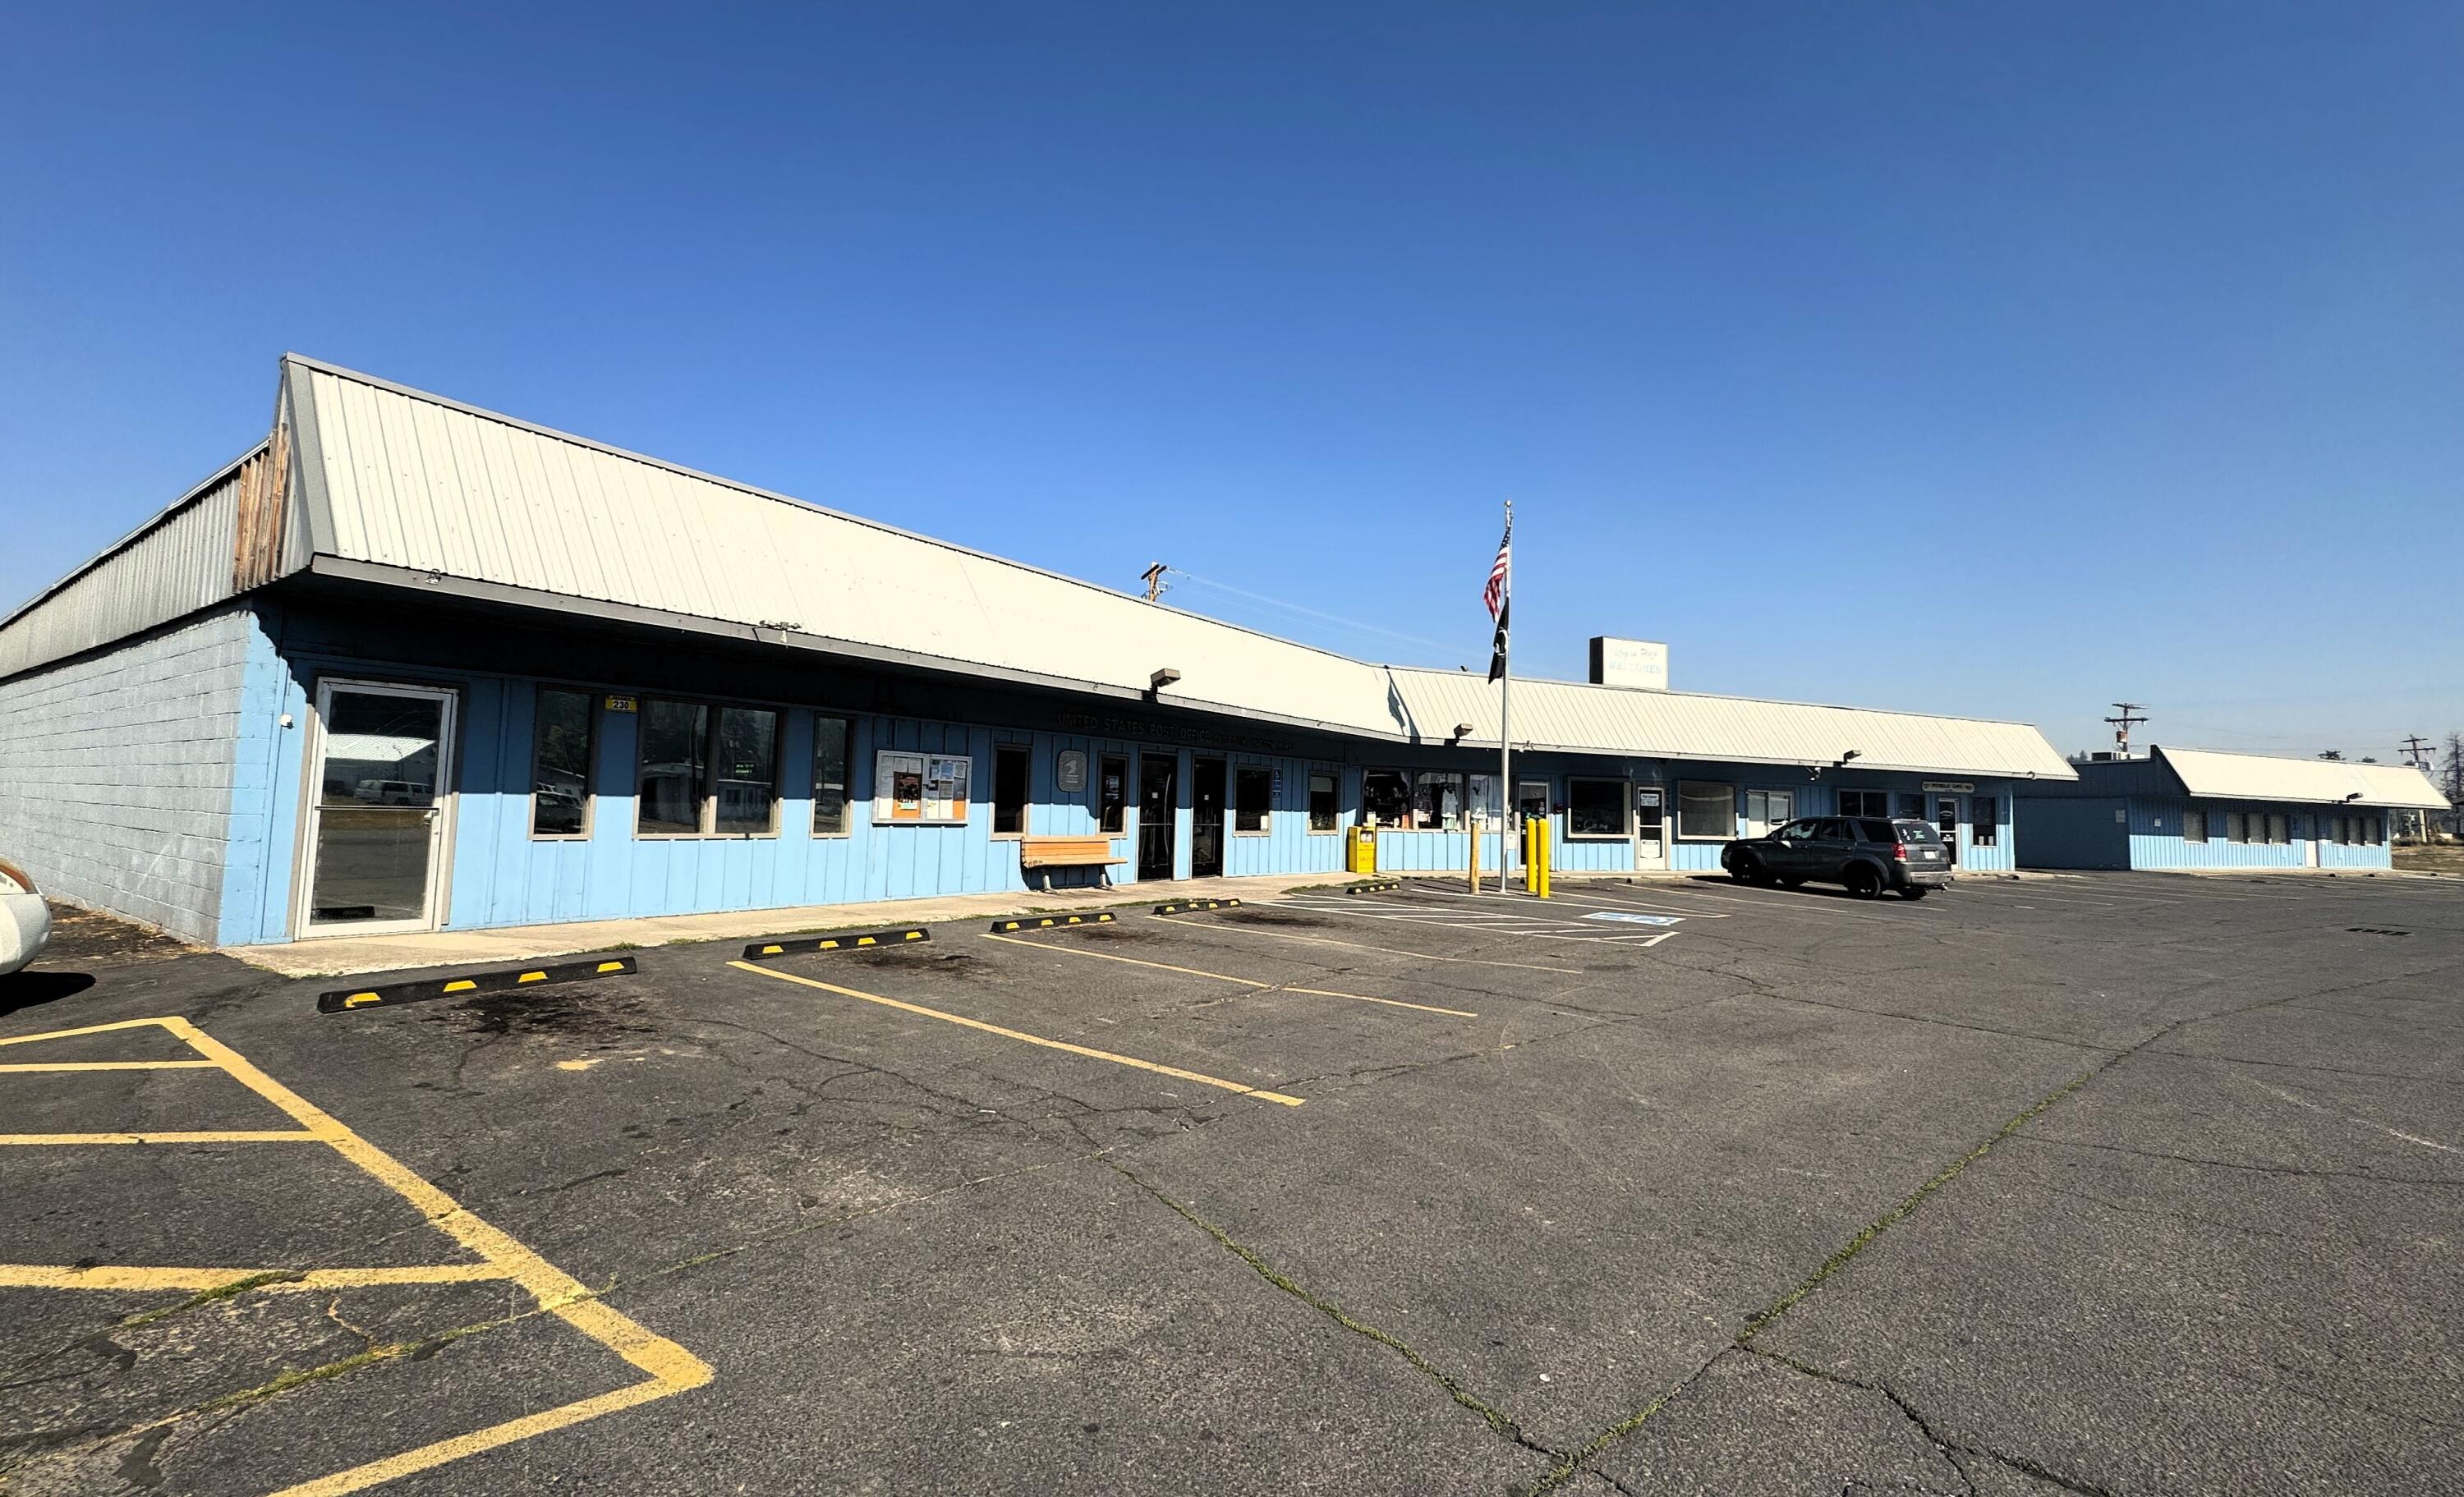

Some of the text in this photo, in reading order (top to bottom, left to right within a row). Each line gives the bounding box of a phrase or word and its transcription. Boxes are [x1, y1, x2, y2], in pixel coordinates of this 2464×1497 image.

[613, 700, 629, 709] 230
[1058, 710, 1098, 729] UNITED
[1104, 718, 1144, 735] STATES
[1149, 722, 1174, 737] POST
[1179, 726, 1210, 743] OFFICE
